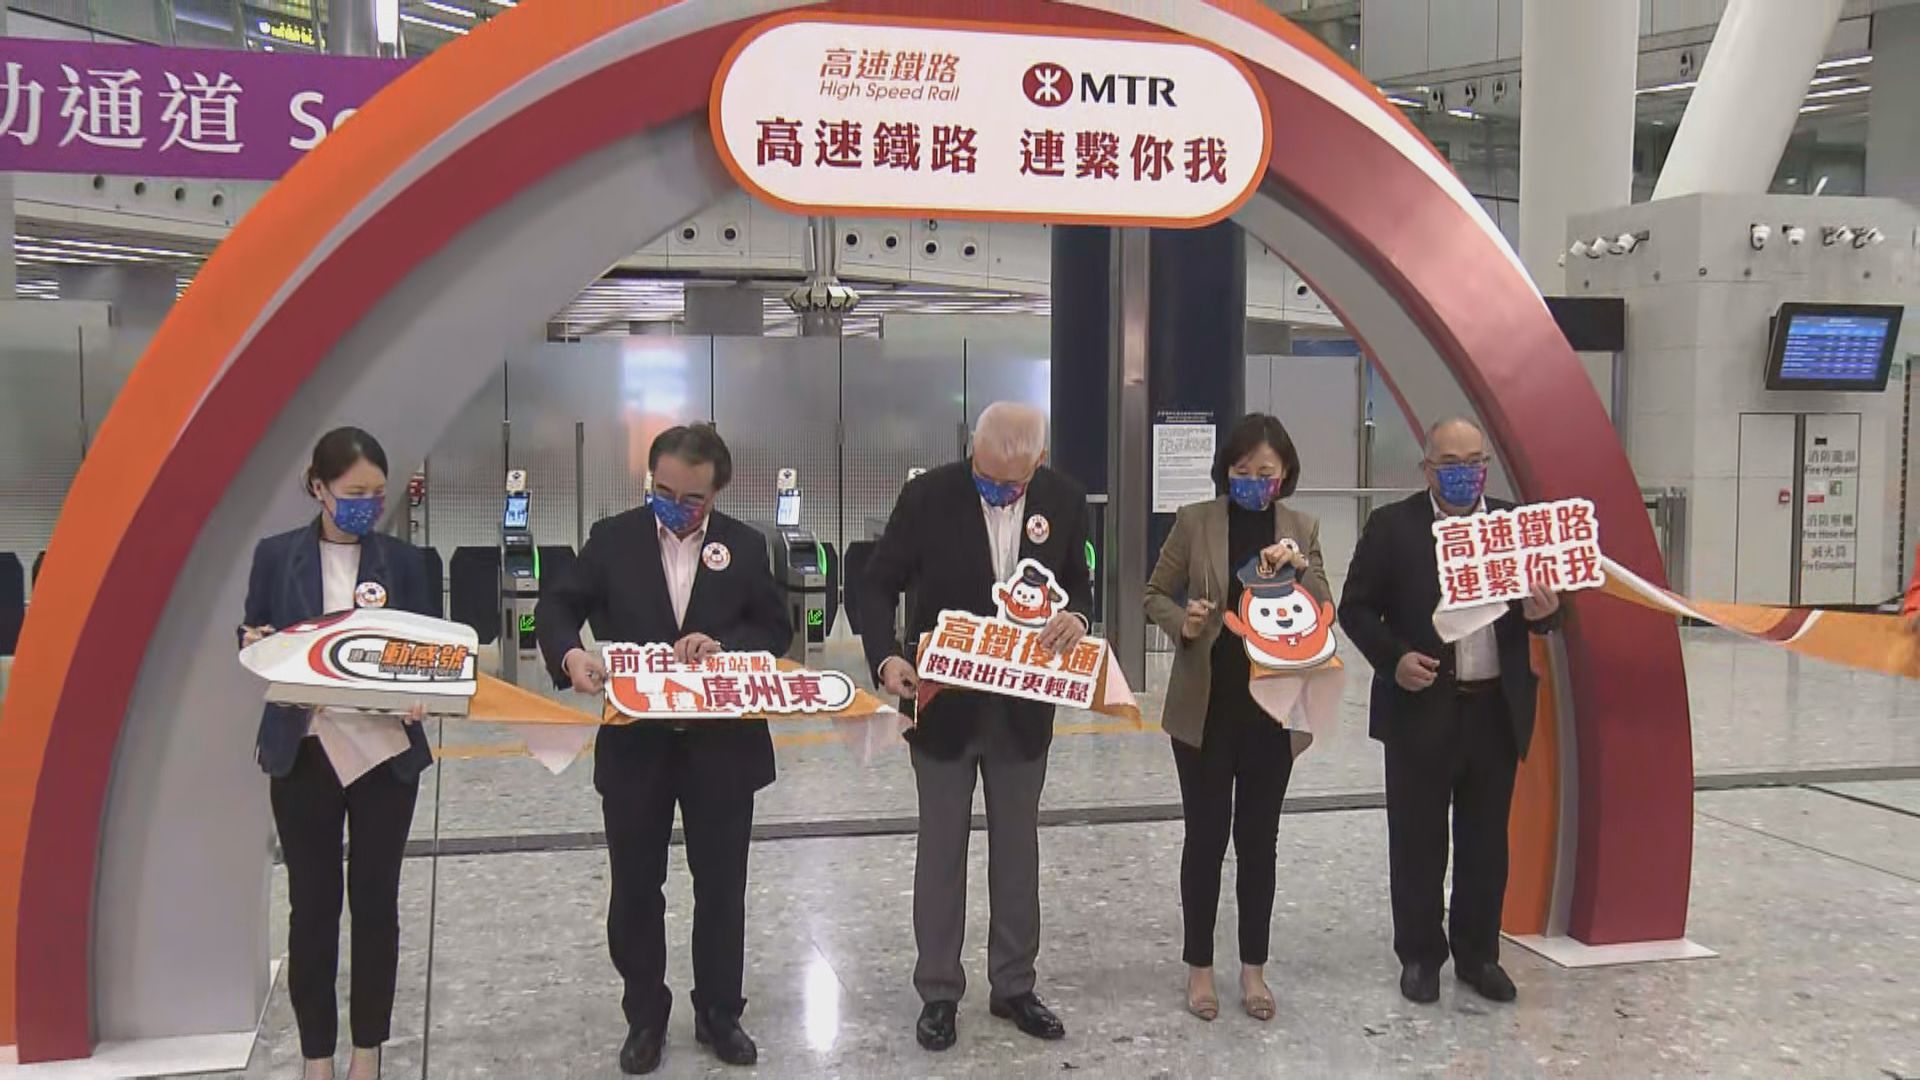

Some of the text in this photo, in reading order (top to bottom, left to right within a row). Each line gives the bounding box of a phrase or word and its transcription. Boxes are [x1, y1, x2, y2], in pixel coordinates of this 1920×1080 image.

[819, 48, 961, 84] 高速鐵路
[819, 80, 960, 103] High Speed Rail
[1080, 72, 1178, 108] MTR
[755, 116, 1228, 184] 高速鐵路 連繫你我
[1438, 504, 1594, 562] 高速鐵路
[1445, 546, 1600, 605] 連繫你我
[380, 640, 469, 669] 動感號
[607, 647, 678, 673] 前往
[702, 674, 827, 708] 廣州東
[925, 652, 1090, 703] 跨境出行更輕鬆
